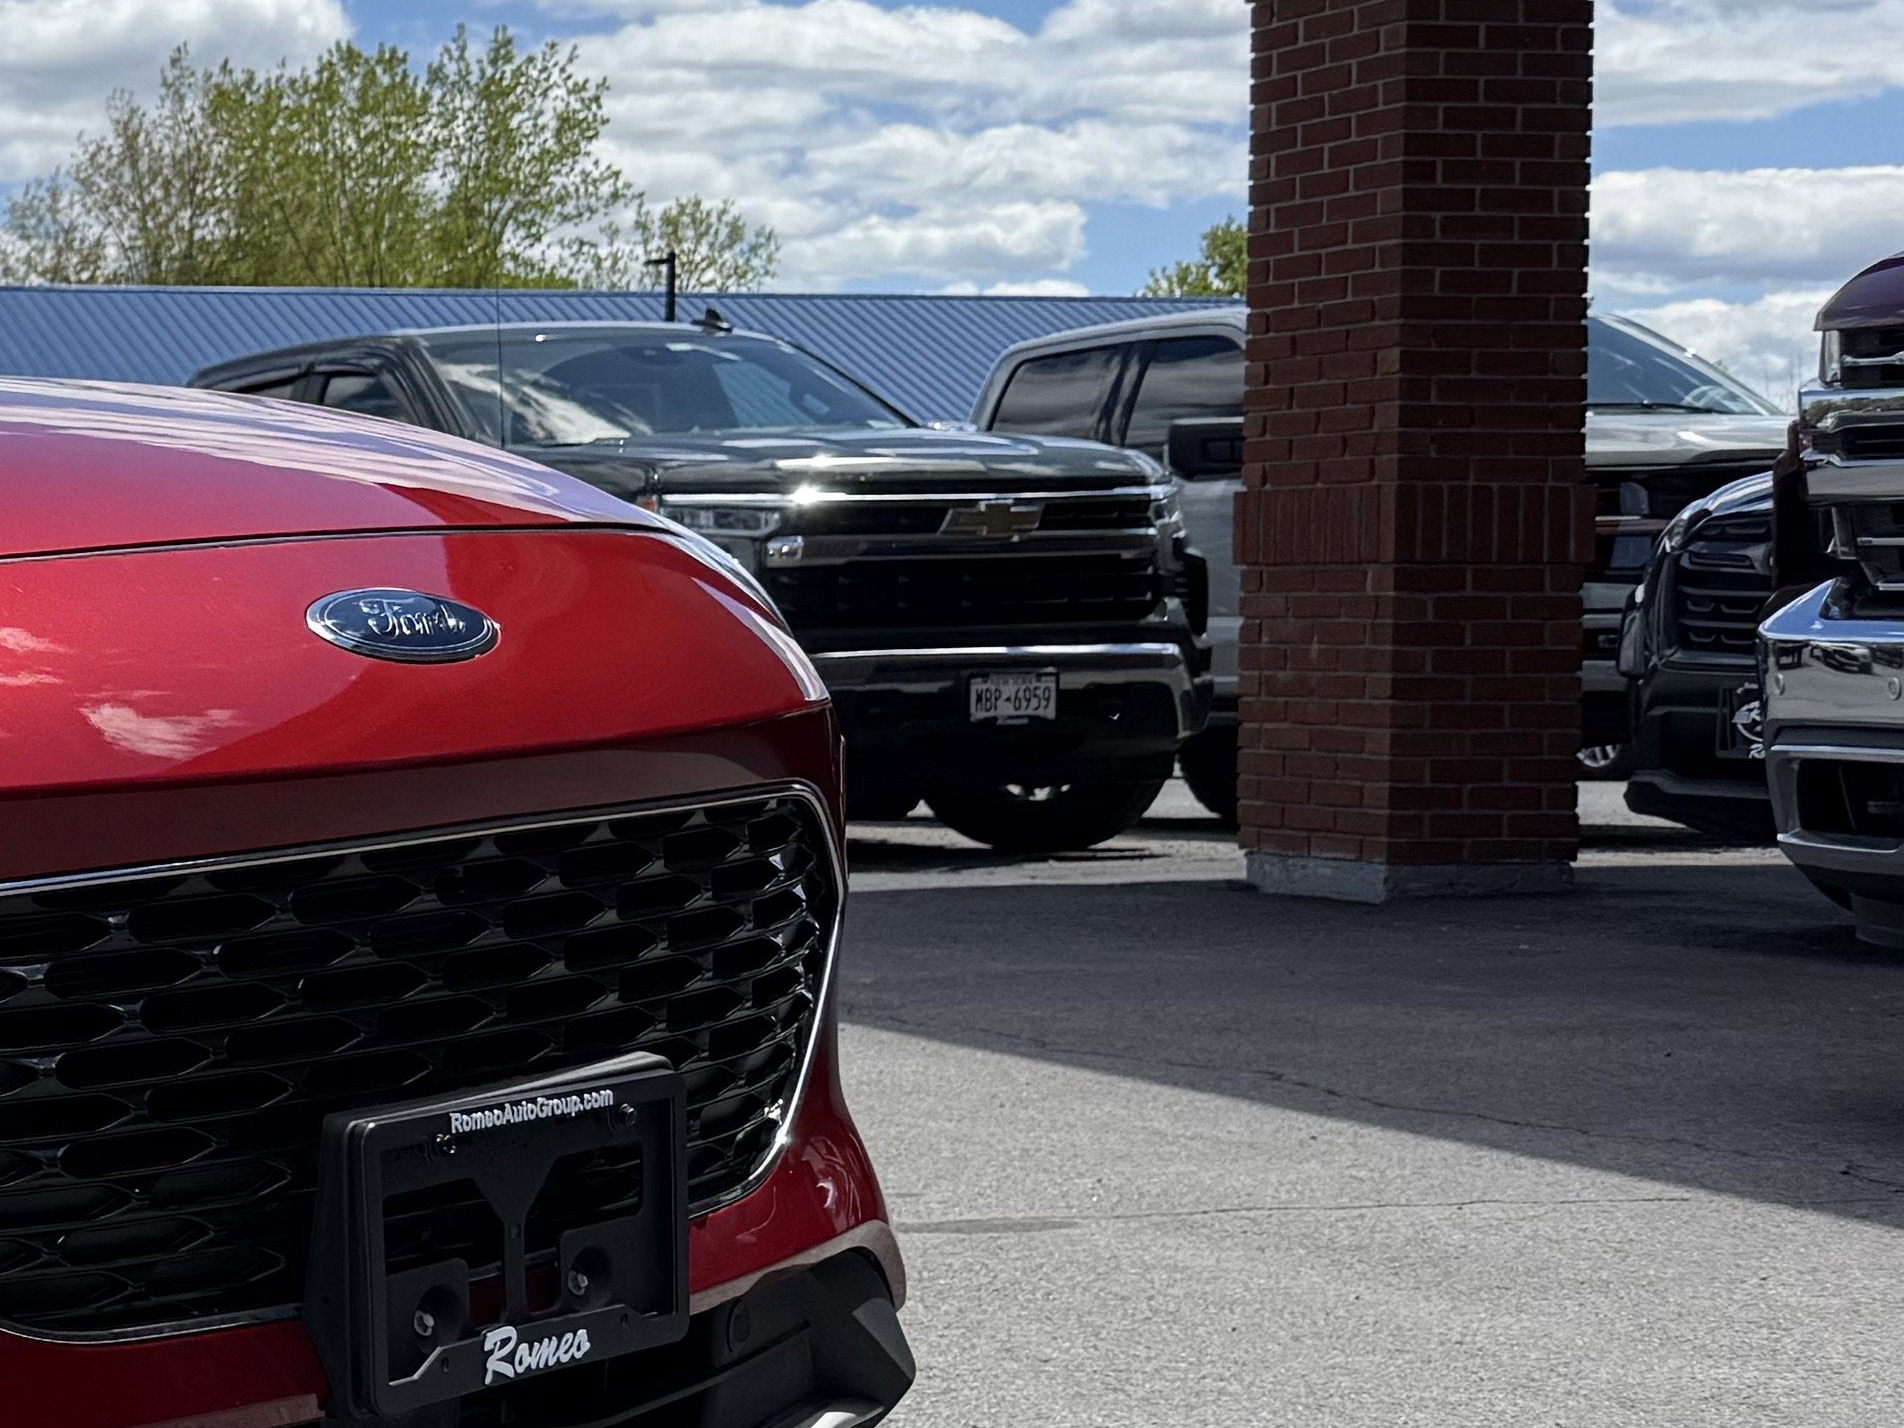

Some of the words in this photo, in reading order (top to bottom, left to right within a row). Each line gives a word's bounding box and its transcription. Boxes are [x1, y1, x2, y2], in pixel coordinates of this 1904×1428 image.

[356, 598, 466, 640] Ford
[449, 1089, 614, 1134] RomeoAutoGroup.com
[484, 1325, 591, 1385] Romeo
